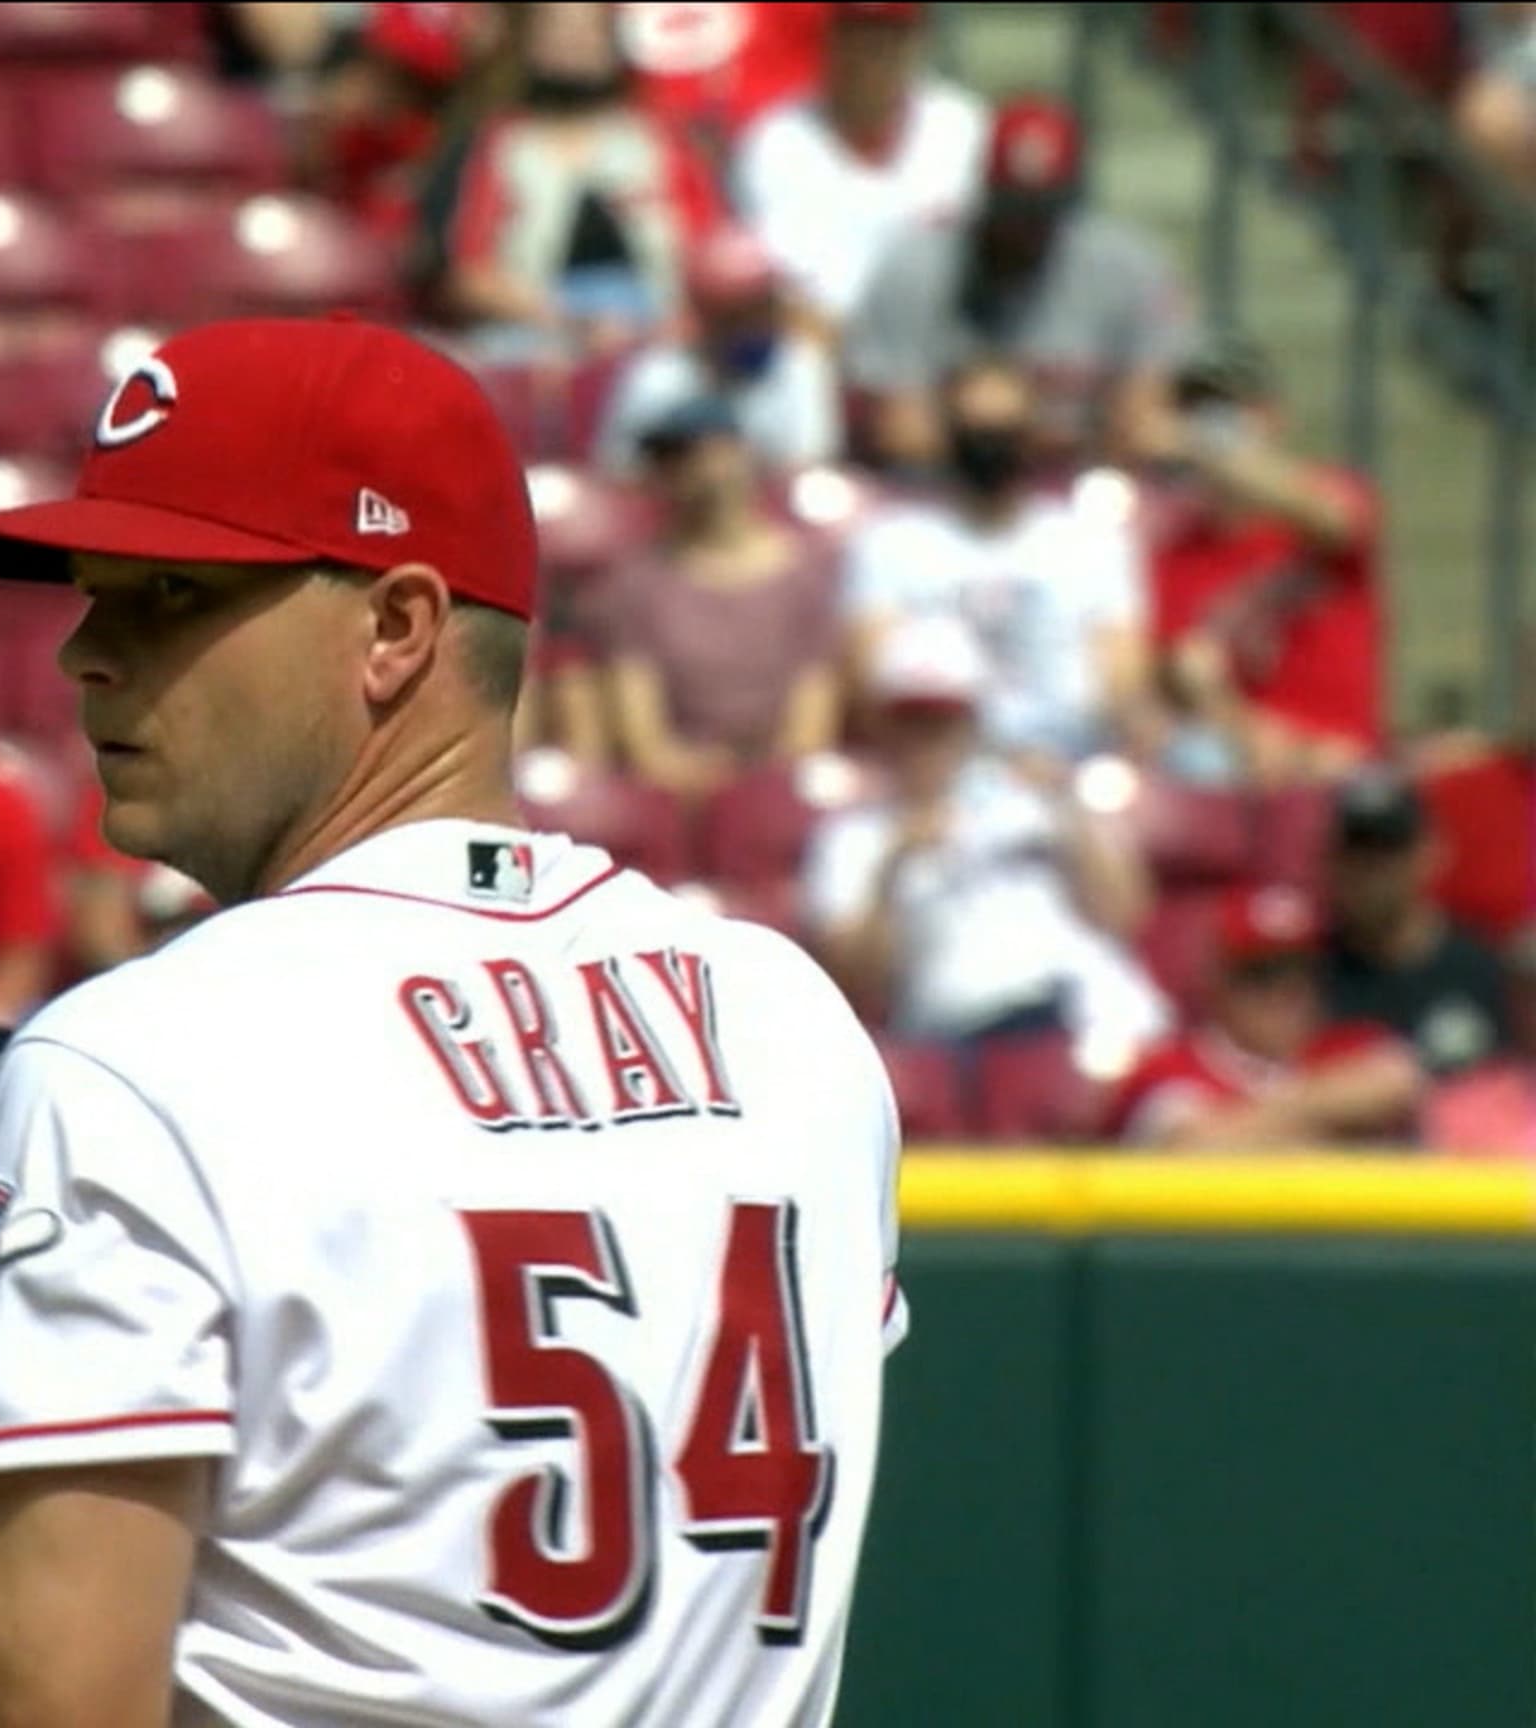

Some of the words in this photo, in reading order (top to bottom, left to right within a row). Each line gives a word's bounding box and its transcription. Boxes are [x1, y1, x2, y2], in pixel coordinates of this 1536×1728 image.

[95, 356, 178, 450] C
[396, 947, 742, 1133] GRAY
[452, 1197, 837, 1653] 54
